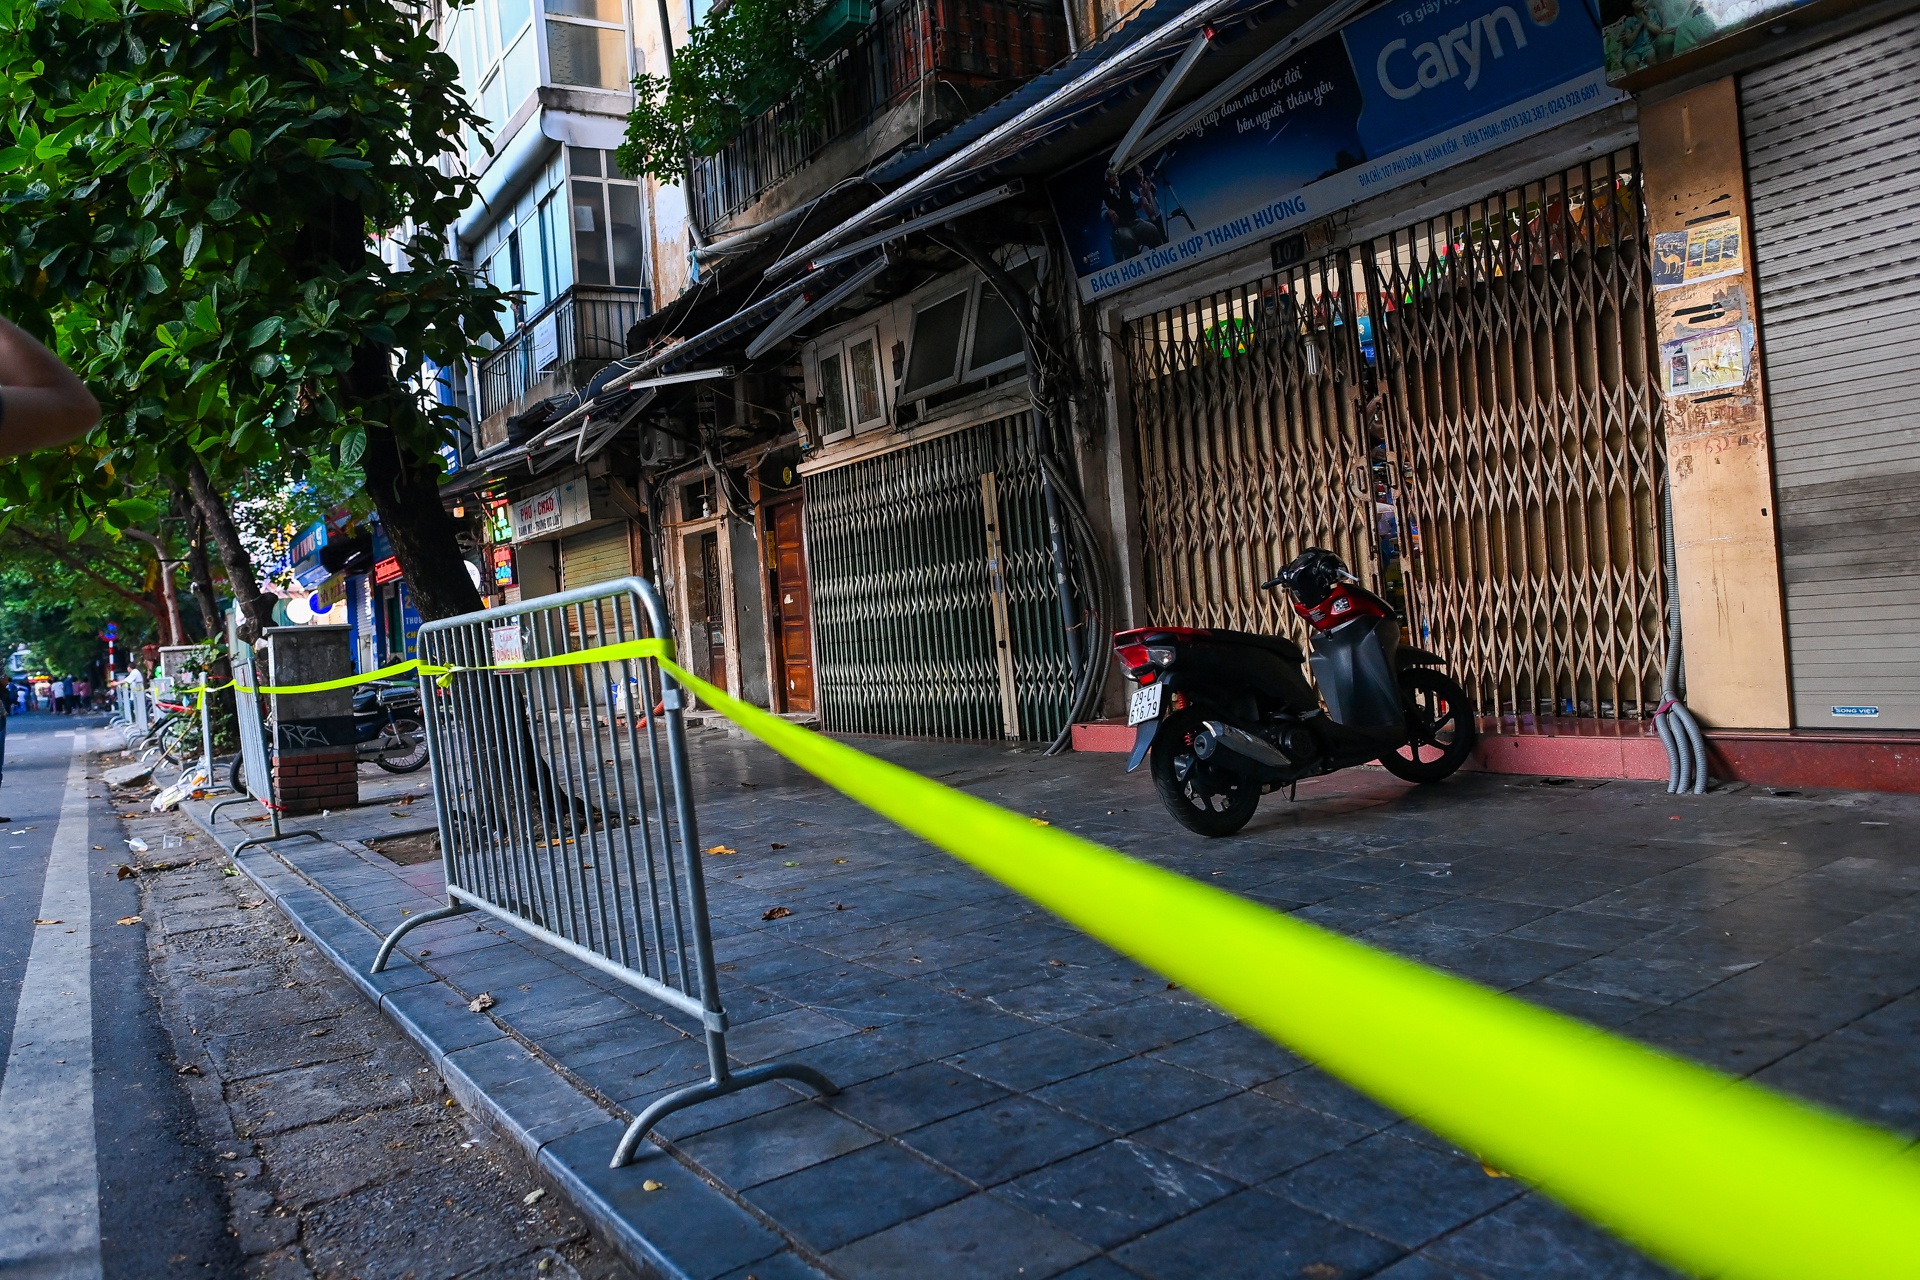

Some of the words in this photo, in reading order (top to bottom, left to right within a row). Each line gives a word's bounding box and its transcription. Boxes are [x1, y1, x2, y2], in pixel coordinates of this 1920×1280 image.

[1397, 10, 1413, 26] Tã
[1376, 5, 1529, 100] Caryn
[1236, 118, 1255, 134] bên
[1255, 101, 1285, 130] người
[1286, 90, 1313, 110] thân
[1313, 80, 1334, 106] yêu
[1243, 88, 1260, 107] mê
[1259, 78, 1284, 98] cuộc
[1284, 65, 1303, 85] đời
[1358, 174, 1370, 189] ĐỊA
[1369, 165, 1383, 183] CHỈ:
[1381, 163, 1393, 178] 107
[1441, 137, 1460, 156] KIẾM
[1462, 129, 1480, 149] ĐIỆN
[1478, 122, 1503, 142] THOẠI:
[1500, 115, 1519, 132] 0918
[1517, 110, 1533, 126] 382
[1531, 104, 1549, 121] 387;
[1547, 96, 1567, 115] 0243
[1566, 90, 1582, 107] 928
[1580, 82, 1600, 101] 6891
[1090, 270, 1121, 293] BÁCH
[1119, 259, 1146, 282] HÓA
[1144, 248, 1179, 272] TỔNG
[1177, 235, 1204, 259] HỢP
[1204, 216, 1253, 247] THANH
[1252, 195, 1307, 230] HƯƠNG
[1275, 239, 1300, 265] 107
[1130, 701, 1158, 723] 616.79
[1134, 686, 1157, 707] 29-C1
